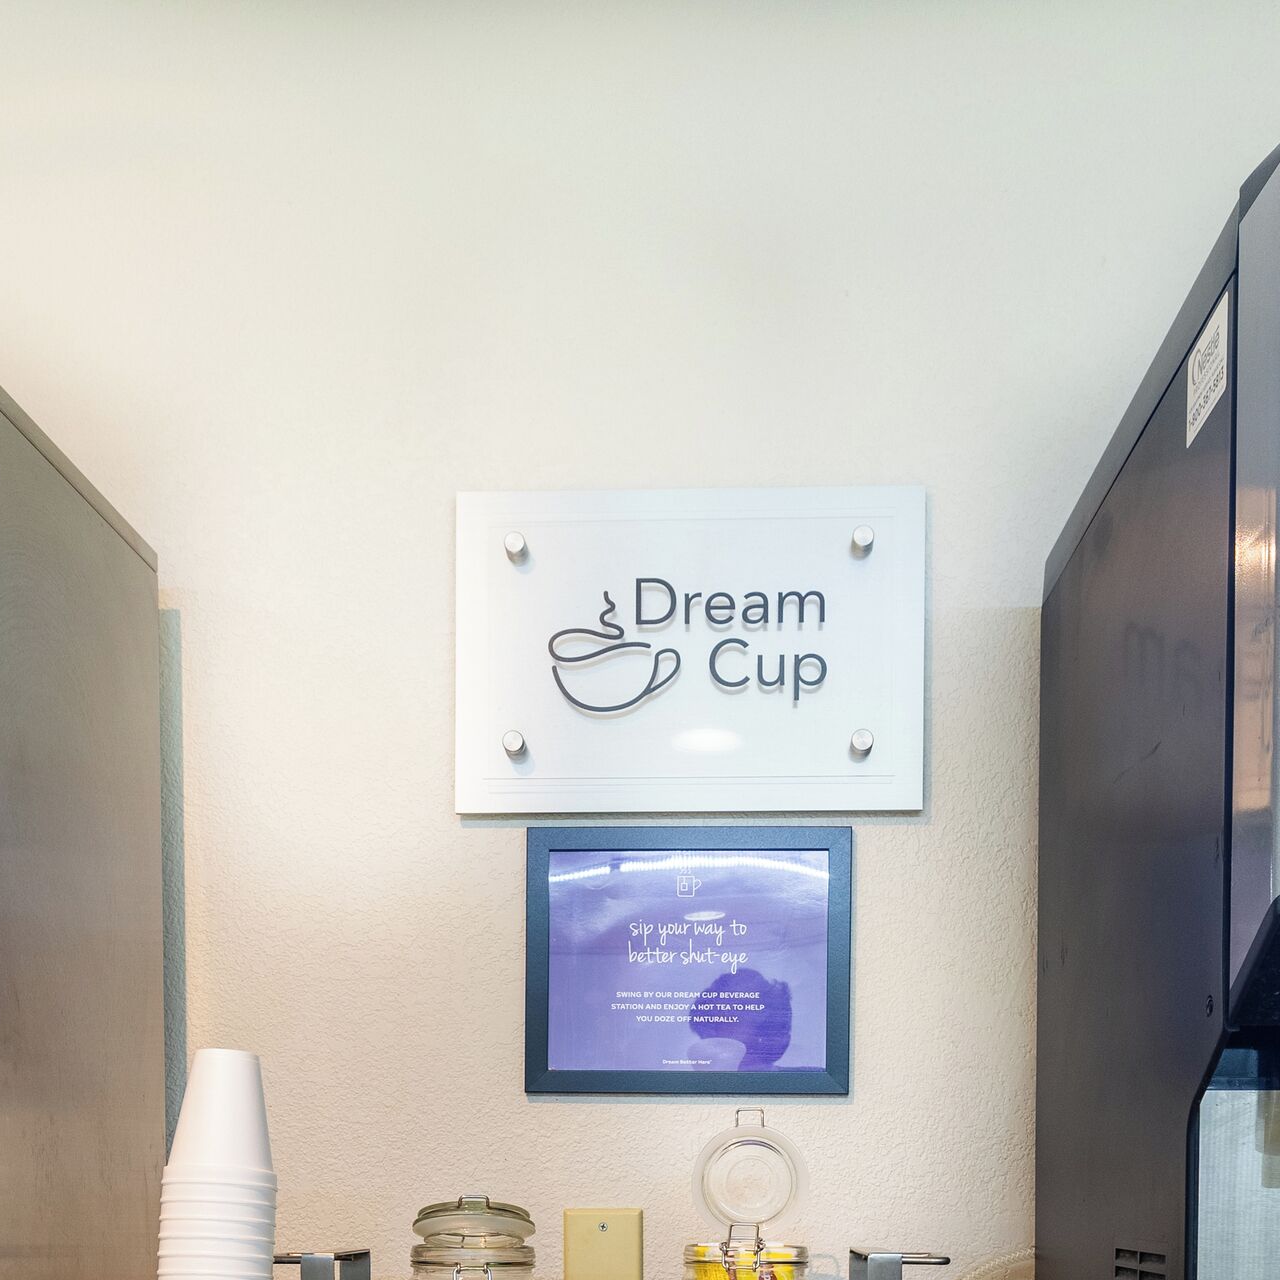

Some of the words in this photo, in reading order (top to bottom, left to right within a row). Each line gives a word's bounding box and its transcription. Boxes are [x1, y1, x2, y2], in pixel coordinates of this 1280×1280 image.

[635, 577, 826, 625] Dream
[708, 637, 827, 701] Cup
[629, 919, 654, 946] sip
[658, 922, 691, 946] your
[694, 922, 726, 946] way
[729, 919, 748, 936] to
[628, 940, 677, 963] better
[680, 938, 749, 975] shut-eye
[611, 1003, 644, 1011] STATION
[646, 1003, 662, 1011] AND
[663, 1003, 689, 1011] ENJOY
[691, 1003, 697, 1011] A
[698, 1003, 713, 1011] HOT
[716, 1003, 731, 1011] TEA
[732, 1003, 744, 1011] TO
[745, 1003, 765, 1011] HELP
[616, 991, 642, 999] SWING
[643, 991, 654, 999] BY
[655, 991, 672, 999] OUR
[673, 991, 700, 999] DREAM
[702, 991, 718, 999] CUP
[719, 991, 760, 999] BEVERAGE
[636, 1015, 653, 1023] YOU
[654, 1015, 675, 1023] DOZE
[676, 1015, 692, 1023] OFF
[693, 1015, 739, 1023] NATURALLY.
